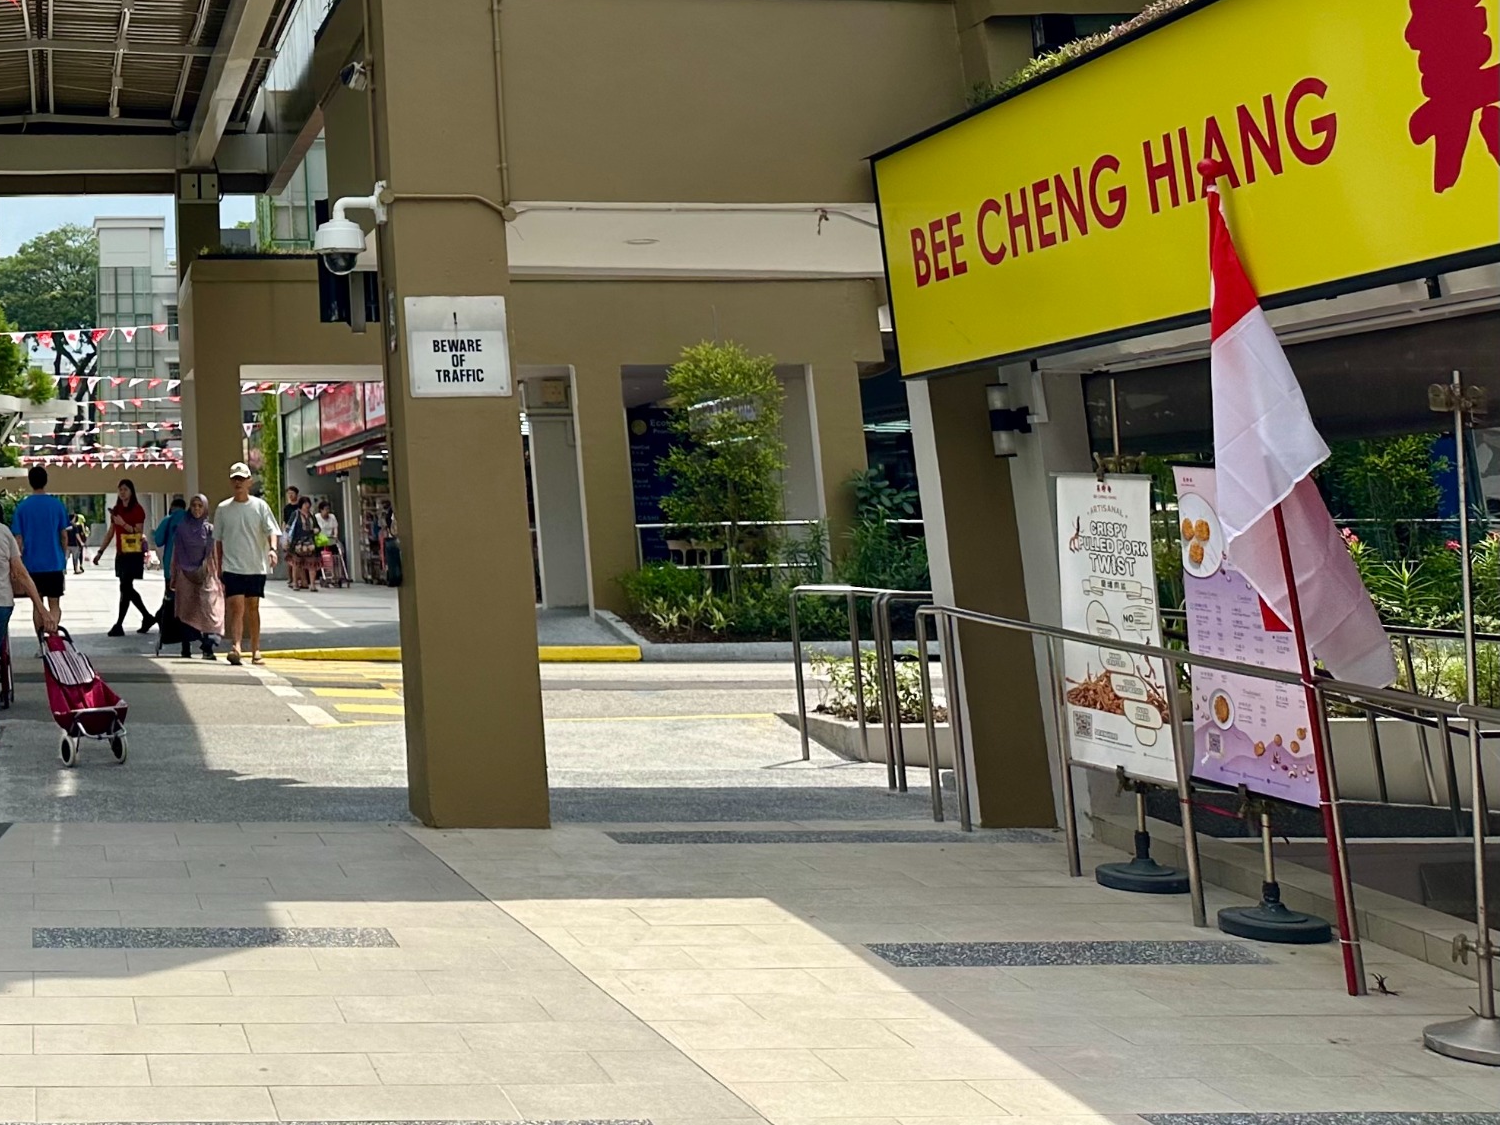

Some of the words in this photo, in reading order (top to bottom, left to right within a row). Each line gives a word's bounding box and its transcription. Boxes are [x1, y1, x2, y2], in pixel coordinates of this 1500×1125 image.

[910, 211, 968, 289] BEE
[976, 153, 1128, 266] CHENG
[1142, 76, 1337, 215] HIANG
[432, 339, 483, 353] BEWARE
[451, 354, 466, 368] OF
[435, 368, 485, 383] TRAFFIC
[1089, 520, 1128, 538] CRISPY
[1078, 536, 1115, 554] PULLED
[1116, 539, 1149, 557] PORK
[1089, 552, 1137, 577] TWIST
[1122, 614, 1134, 623] NO
